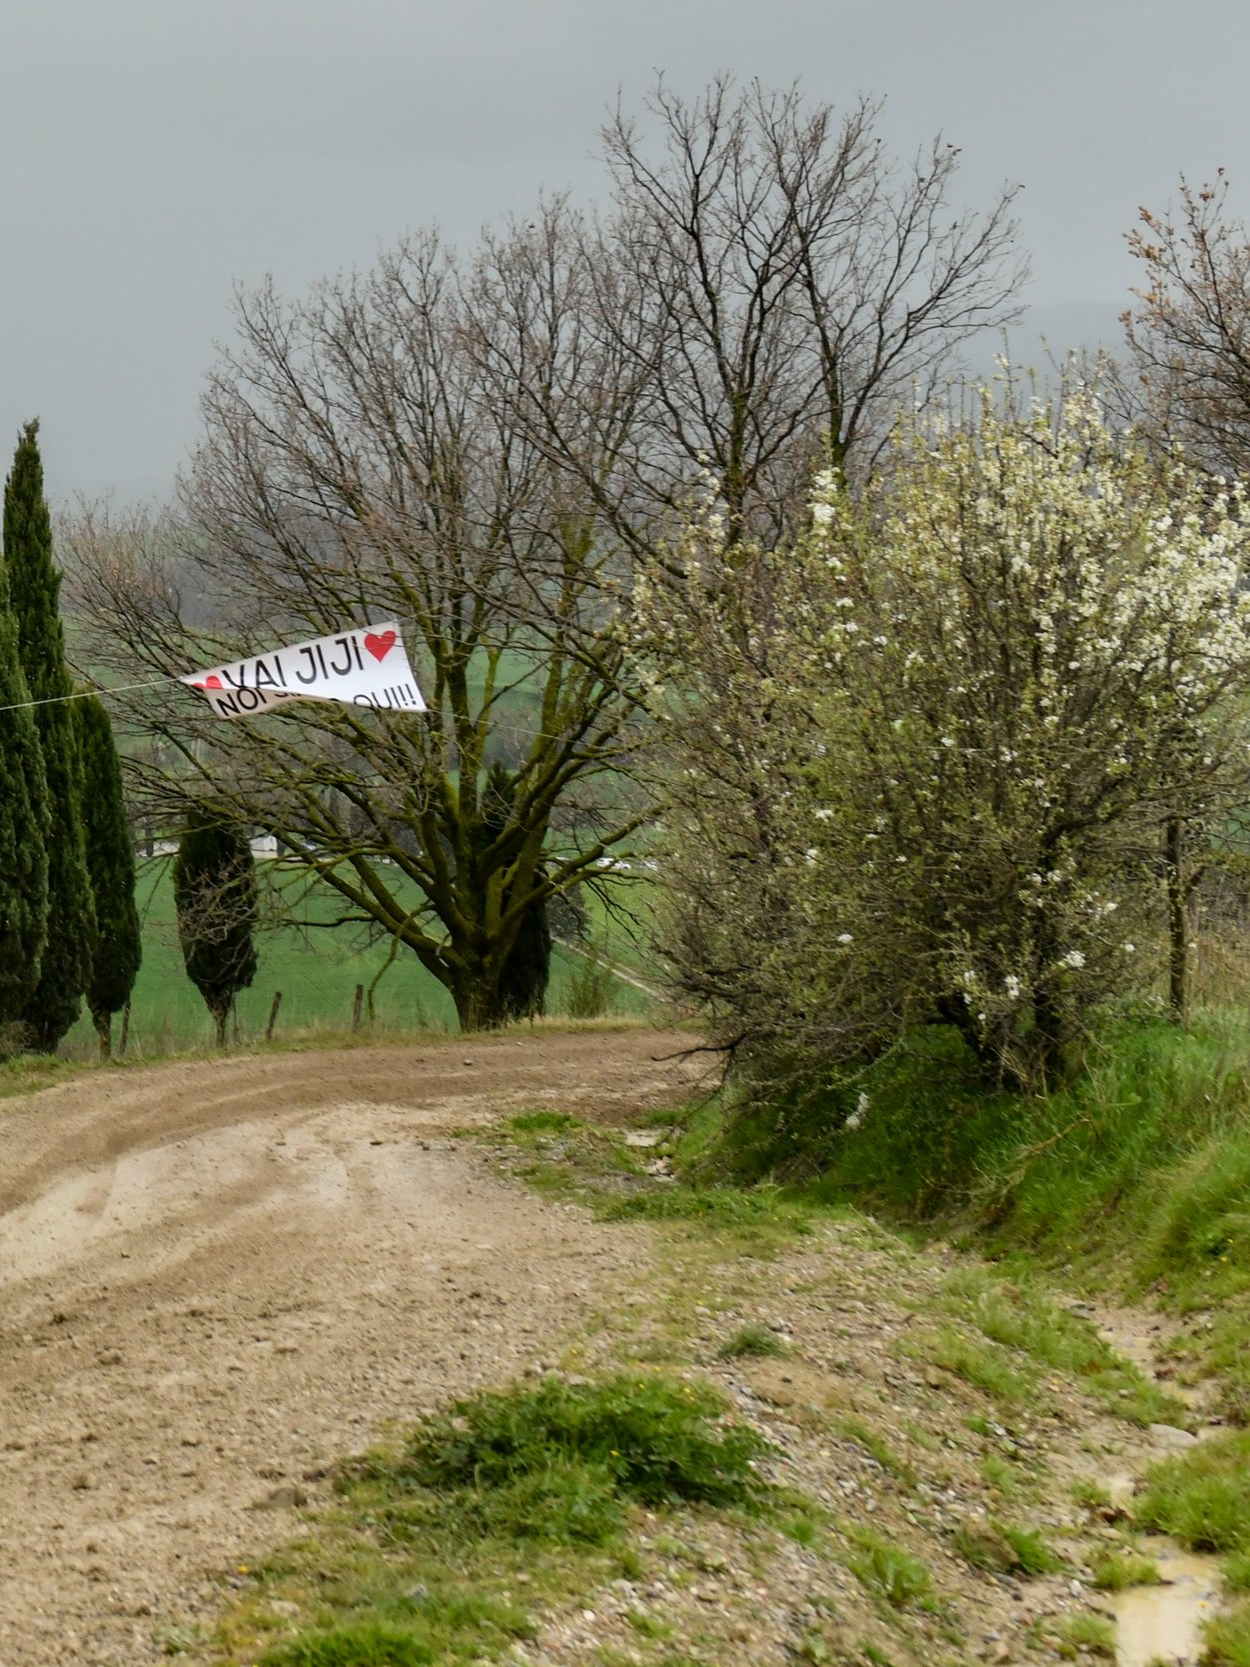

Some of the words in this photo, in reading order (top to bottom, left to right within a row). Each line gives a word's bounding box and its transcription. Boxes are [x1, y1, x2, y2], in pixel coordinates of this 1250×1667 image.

[221, 655, 287, 689] VAI
[296, 636, 364, 684] JIJI
[216, 687, 267, 717] NOI
